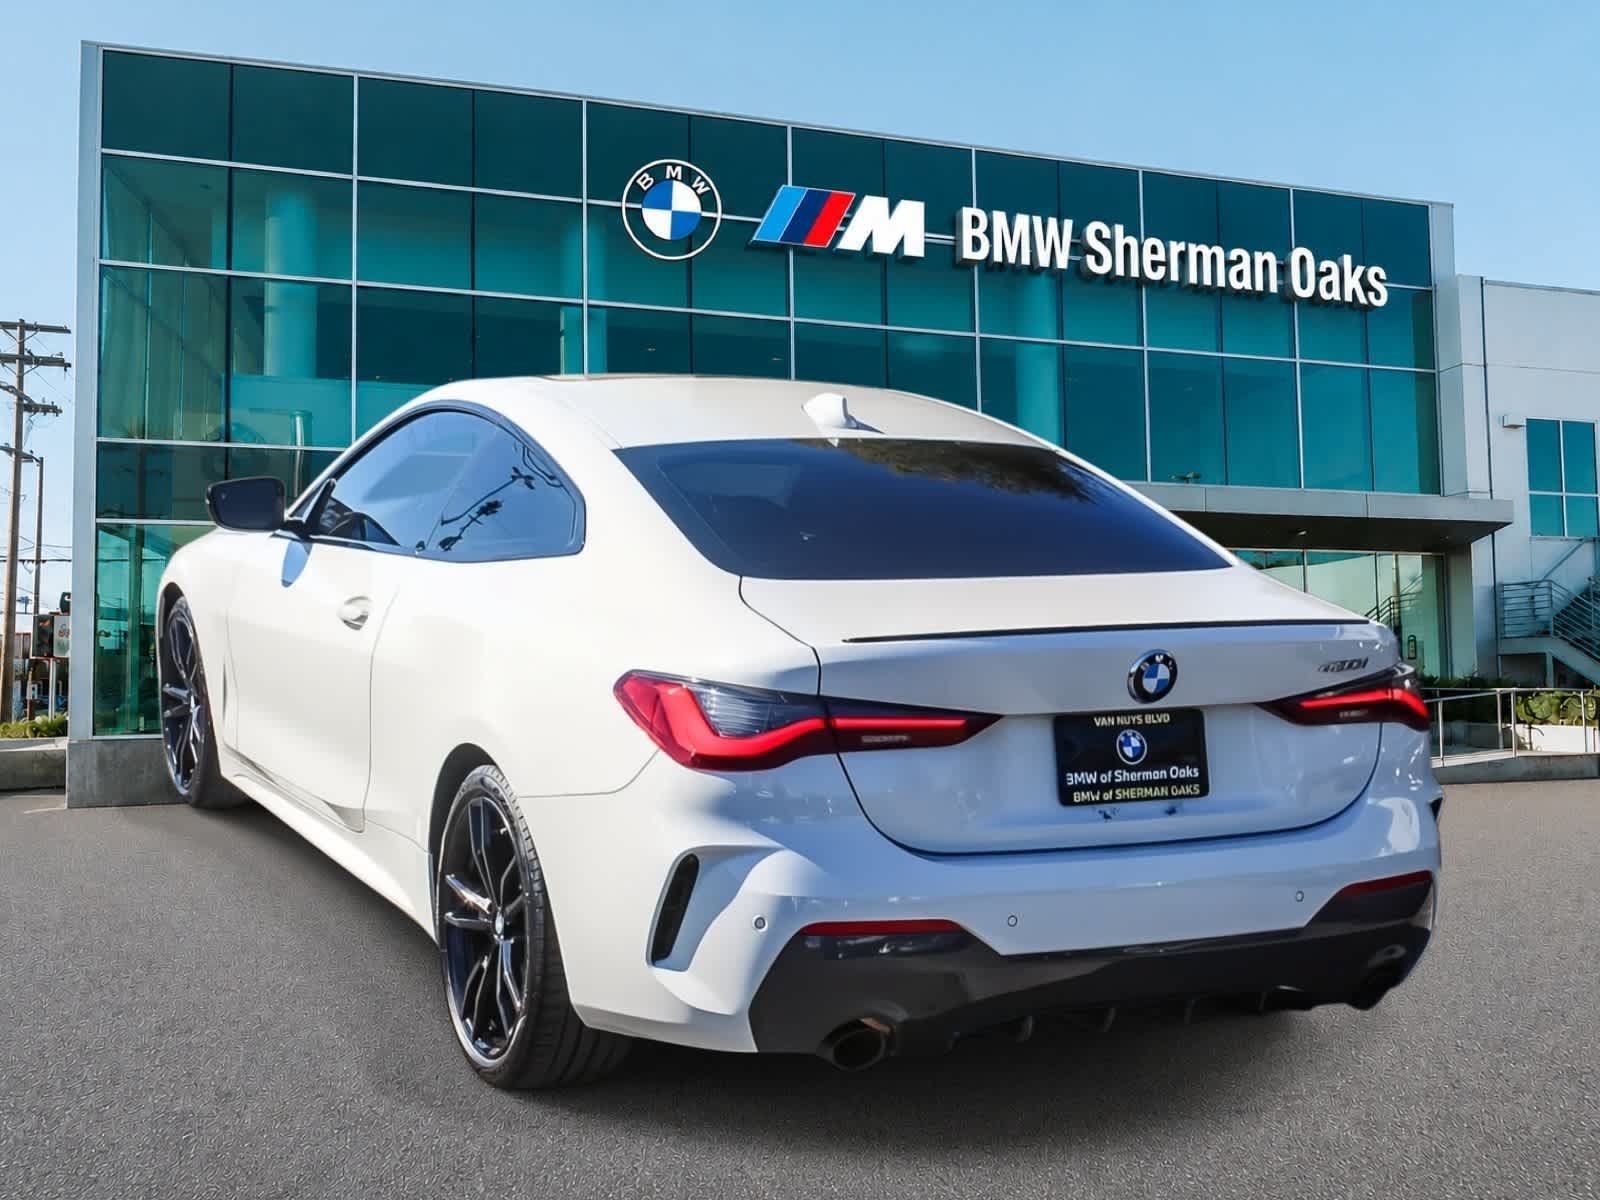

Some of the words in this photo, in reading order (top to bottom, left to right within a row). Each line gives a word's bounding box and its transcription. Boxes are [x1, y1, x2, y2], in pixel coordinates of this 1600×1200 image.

[636, 165, 711, 195] BMW
[834, 195, 925, 258] M
[961, 206, 1074, 270] BMW
[1085, 220, 1279, 293] Sherman
[1289, 247, 1389, 307] Oaks
[1094, 716, 1115, 727] VAN
[1116, 715, 1143, 726] NUYS
[1144, 713, 1170, 724] BLVD
[1100, 771, 1113, 783] of
[1114, 768, 1168, 783] Sherman
[1169, 766, 1199, 779] Oaks
[1073, 790, 1100, 803] BMW
[1102, 789, 1113, 800] of
[1115, 786, 1168, 800] SHERMAN
[1170, 784, 1200, 796] OAKS
